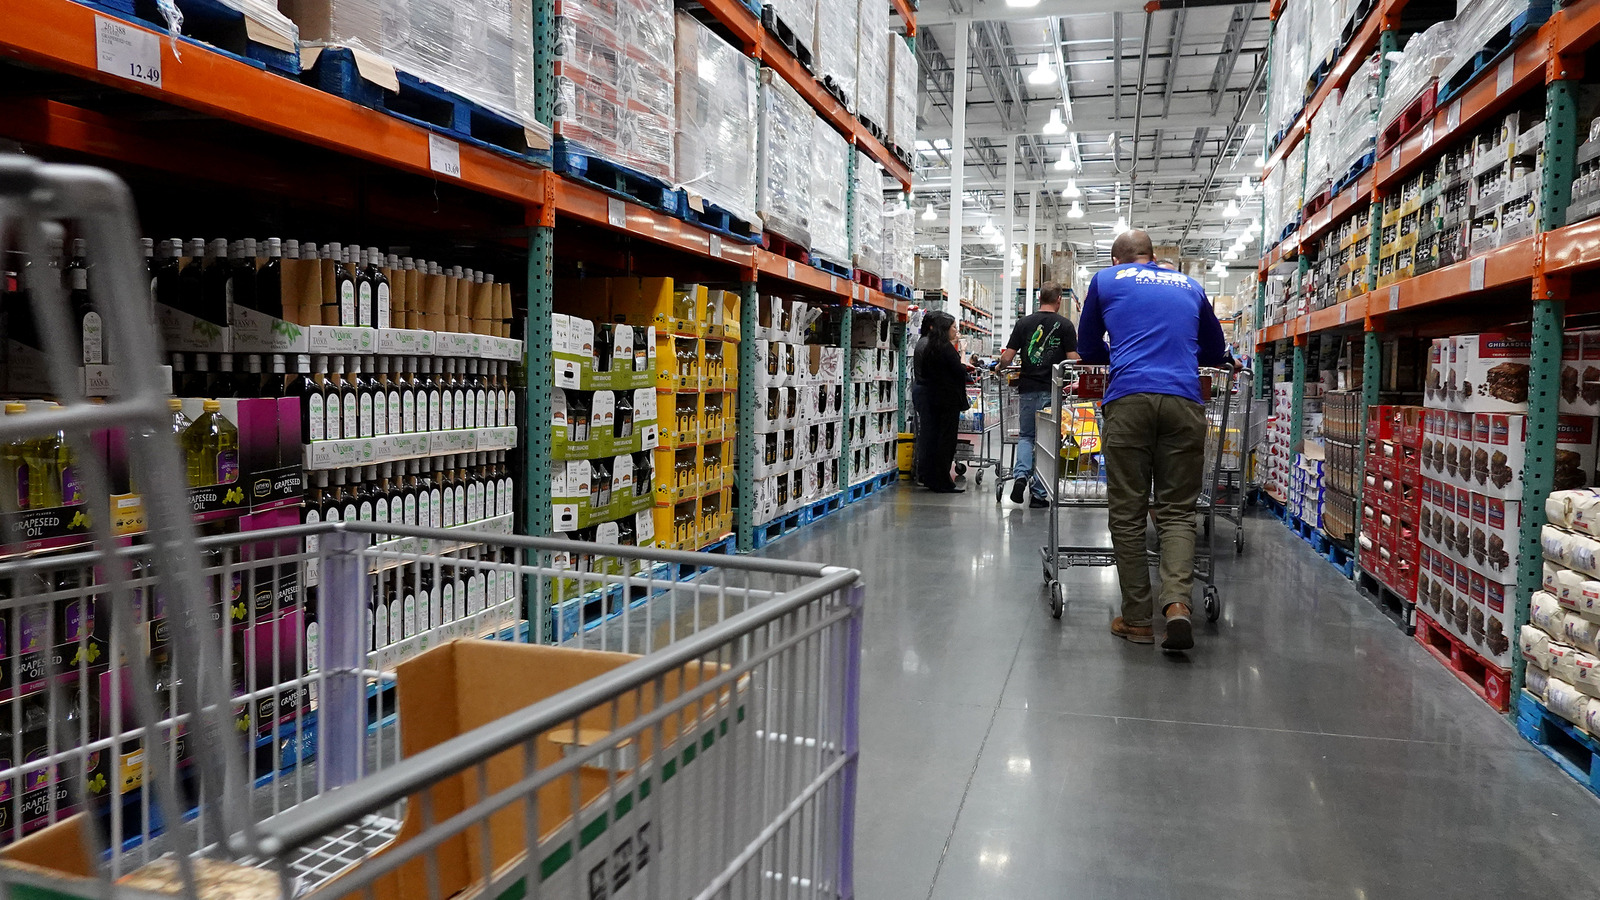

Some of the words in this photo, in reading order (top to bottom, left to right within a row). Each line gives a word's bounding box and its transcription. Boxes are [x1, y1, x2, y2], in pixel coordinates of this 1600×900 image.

[130, 62, 160, 83] 12.49
[274, 478, 301, 490] GRAPESEED
[188, 493, 217, 504] RAPESEED
[194, 502, 206, 510] OIL
[26, 527, 44, 537] OIL
[284, 594, 294, 602] OIL
[30, 668, 45, 678] OIL
